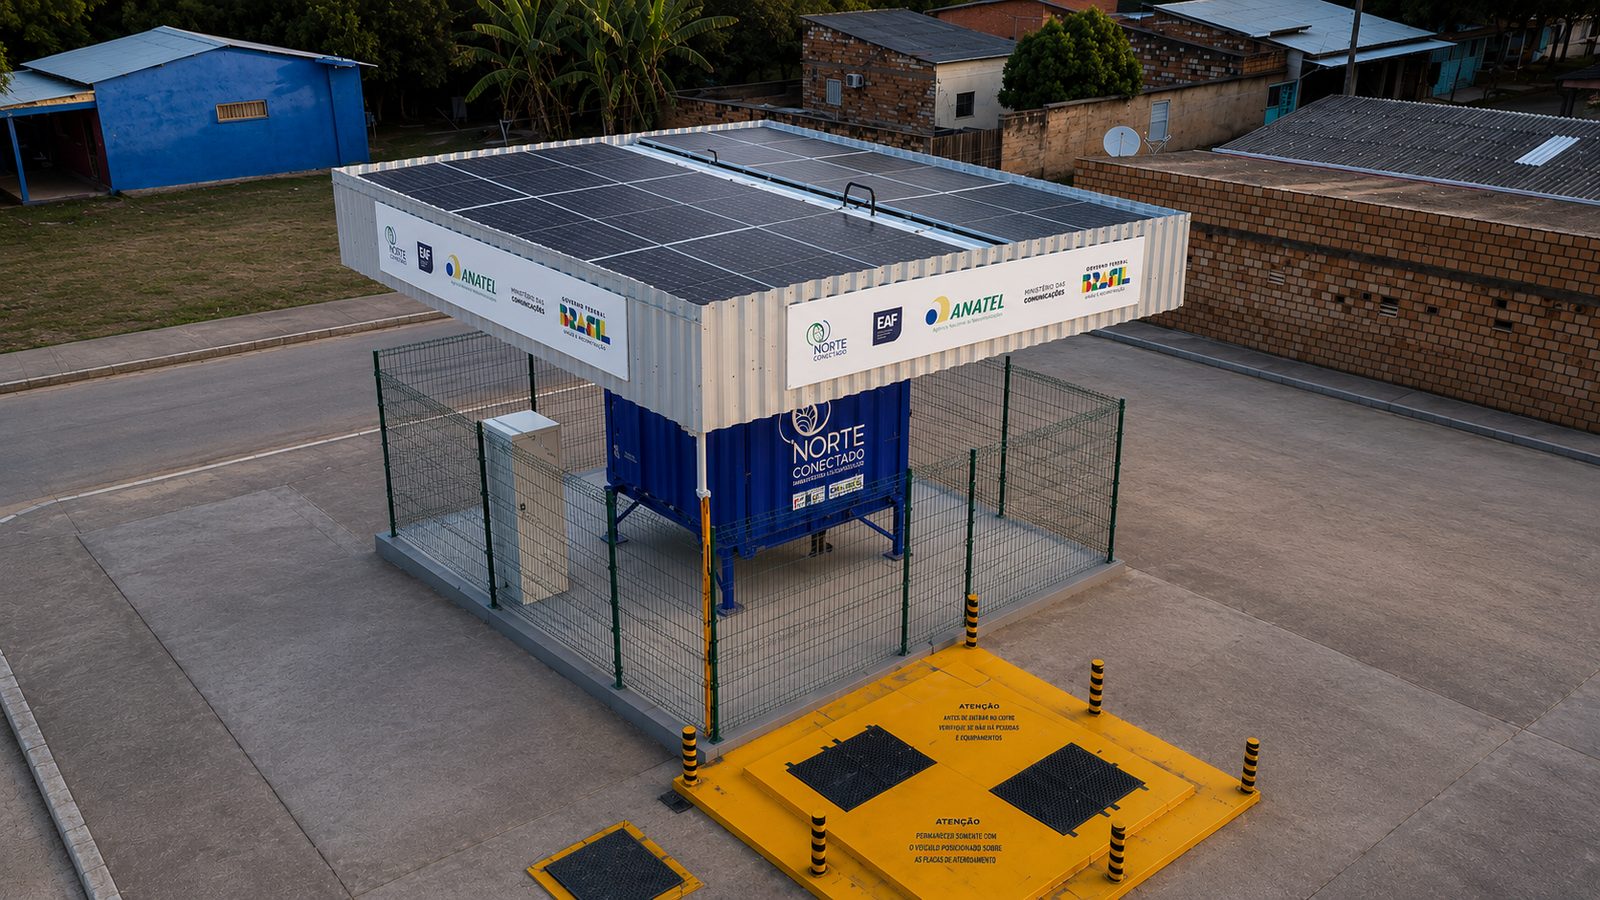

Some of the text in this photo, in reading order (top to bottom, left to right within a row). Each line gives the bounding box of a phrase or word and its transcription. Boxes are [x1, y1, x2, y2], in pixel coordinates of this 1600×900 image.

[461, 269, 497, 295] ANATEL
[1081, 267, 1130, 293] BRASIL
[950, 294, 1004, 320] ANATEL
[559, 303, 611, 345] BRASIL
[877, 312, 898, 329] EAF
[813, 338, 848, 355] NORTE
[791, 424, 865, 464] NORTE
[793, 448, 865, 478] CONECTADO
[959, 702, 1000, 711] ATENÇÃO
[936, 817, 980, 827] ATENÇÃO
[914, 856, 922, 864] AS
